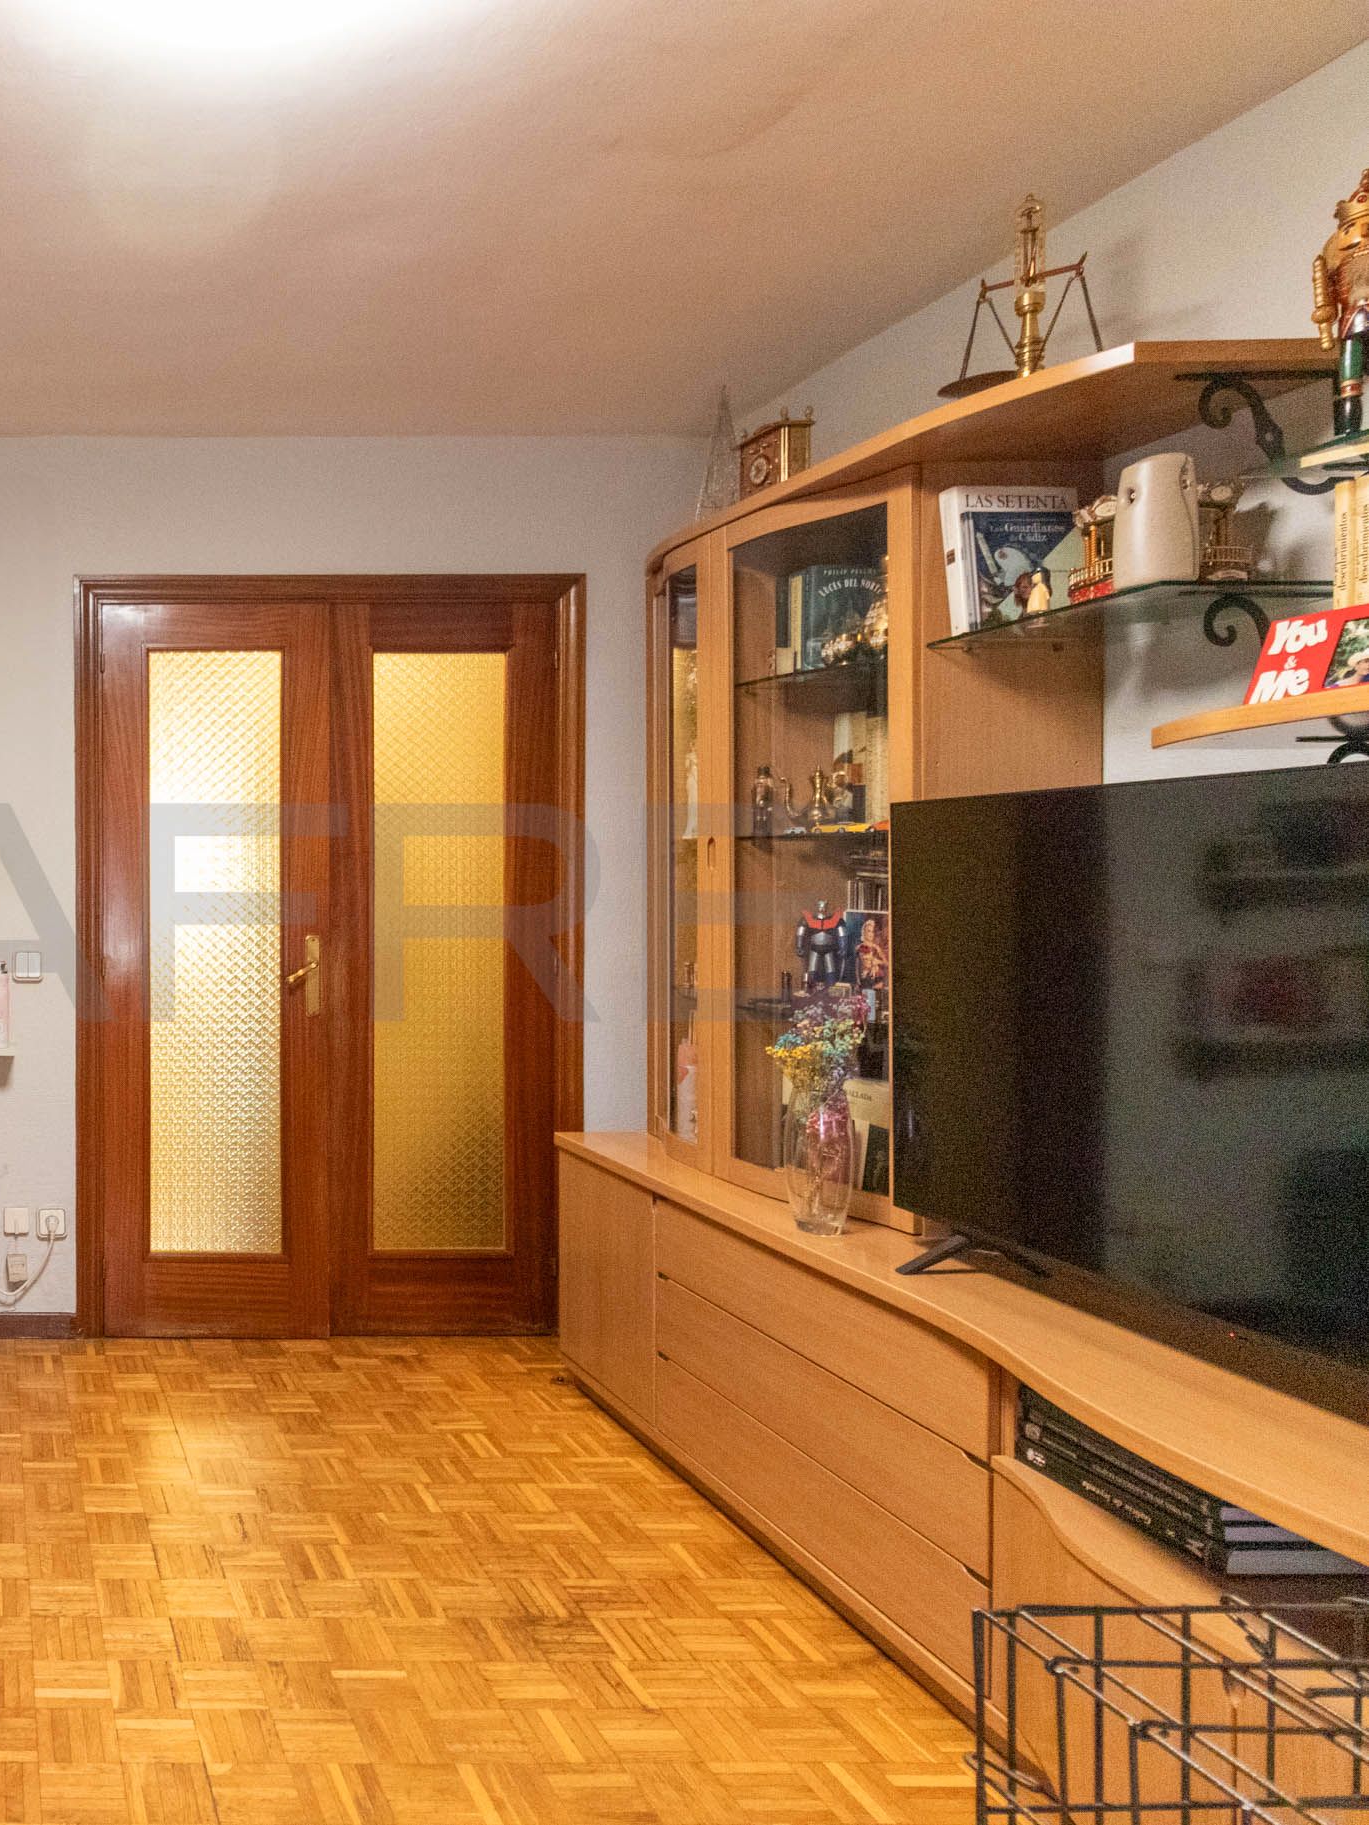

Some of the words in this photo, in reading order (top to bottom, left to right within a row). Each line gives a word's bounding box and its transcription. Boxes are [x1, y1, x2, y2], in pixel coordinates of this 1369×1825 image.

[965, 494, 992, 508] LAS
[997, 494, 1068, 508] SETENTA
[1335, 512, 1347, 590] descubrimientos
[1267, 618, 1328, 655] You
[1283, 655, 1297, 670] &
[1249, 667, 1310, 705] Me
